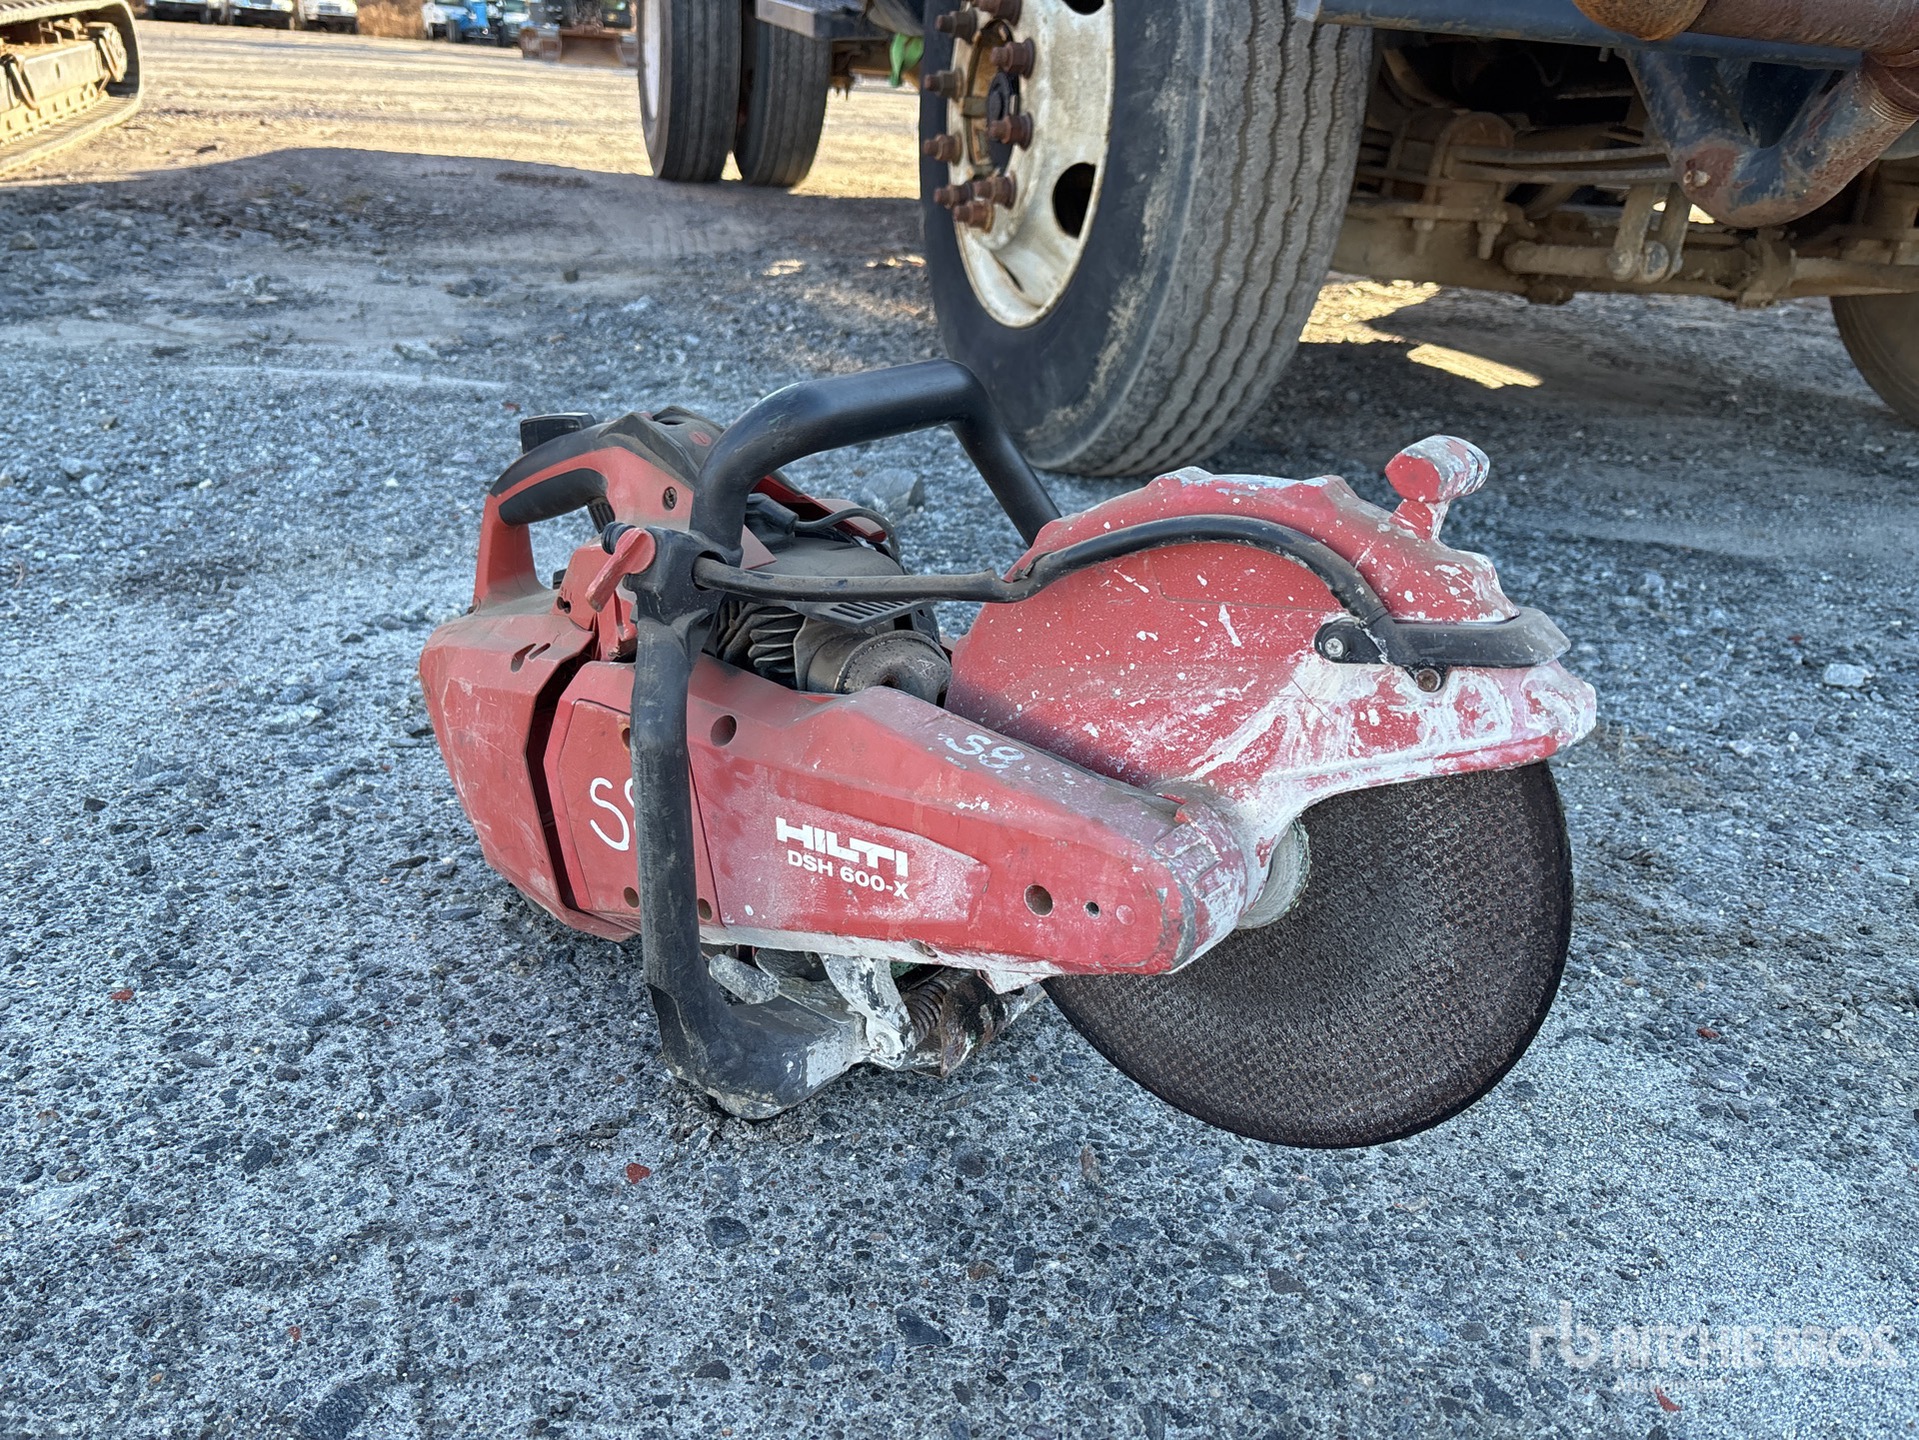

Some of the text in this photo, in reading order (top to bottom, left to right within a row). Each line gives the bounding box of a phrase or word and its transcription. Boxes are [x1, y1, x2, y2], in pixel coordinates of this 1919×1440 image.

[938, 733, 1026, 770] S8
[589, 777, 636, 851] S
[775, 817, 909, 877] HILTI
[787, 850, 910, 900] DSH 600-X
